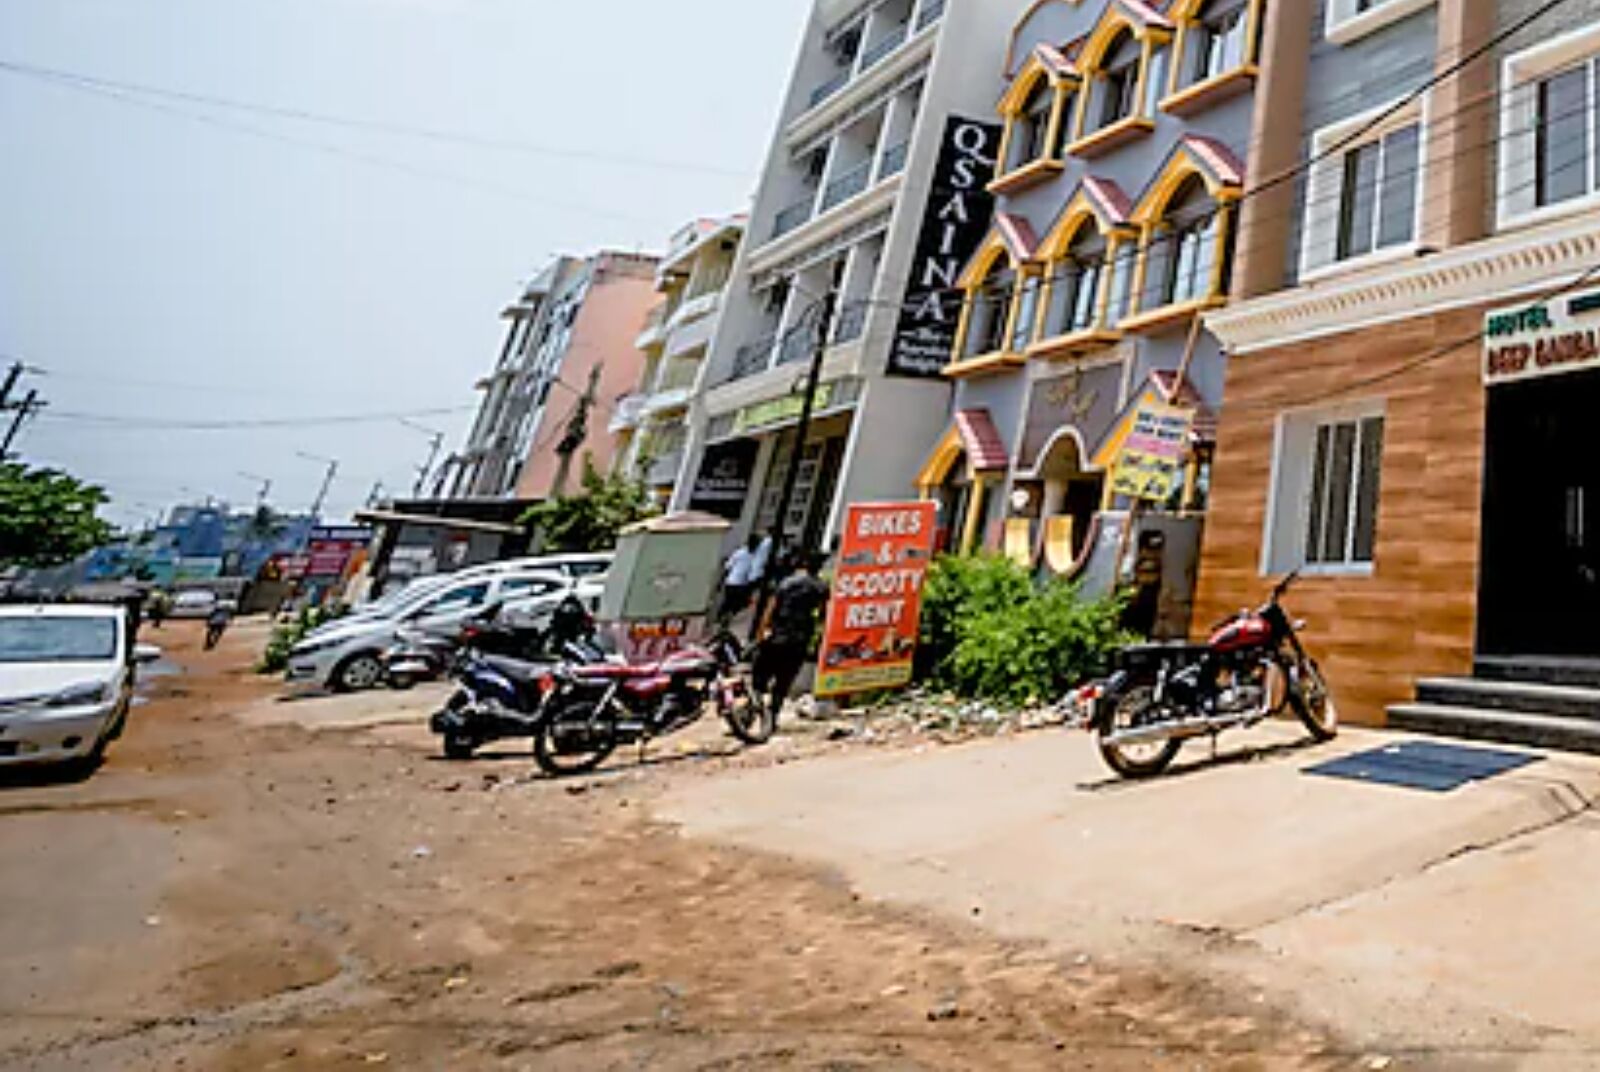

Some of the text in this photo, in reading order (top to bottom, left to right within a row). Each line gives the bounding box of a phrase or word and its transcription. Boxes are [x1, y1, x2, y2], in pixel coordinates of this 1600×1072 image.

[1487, 305, 1553, 338] HOTEL
[857, 511, 922, 538] BIKES
[835, 568, 926, 597] SCOOTY
[845, 599, 905, 628] RENT
